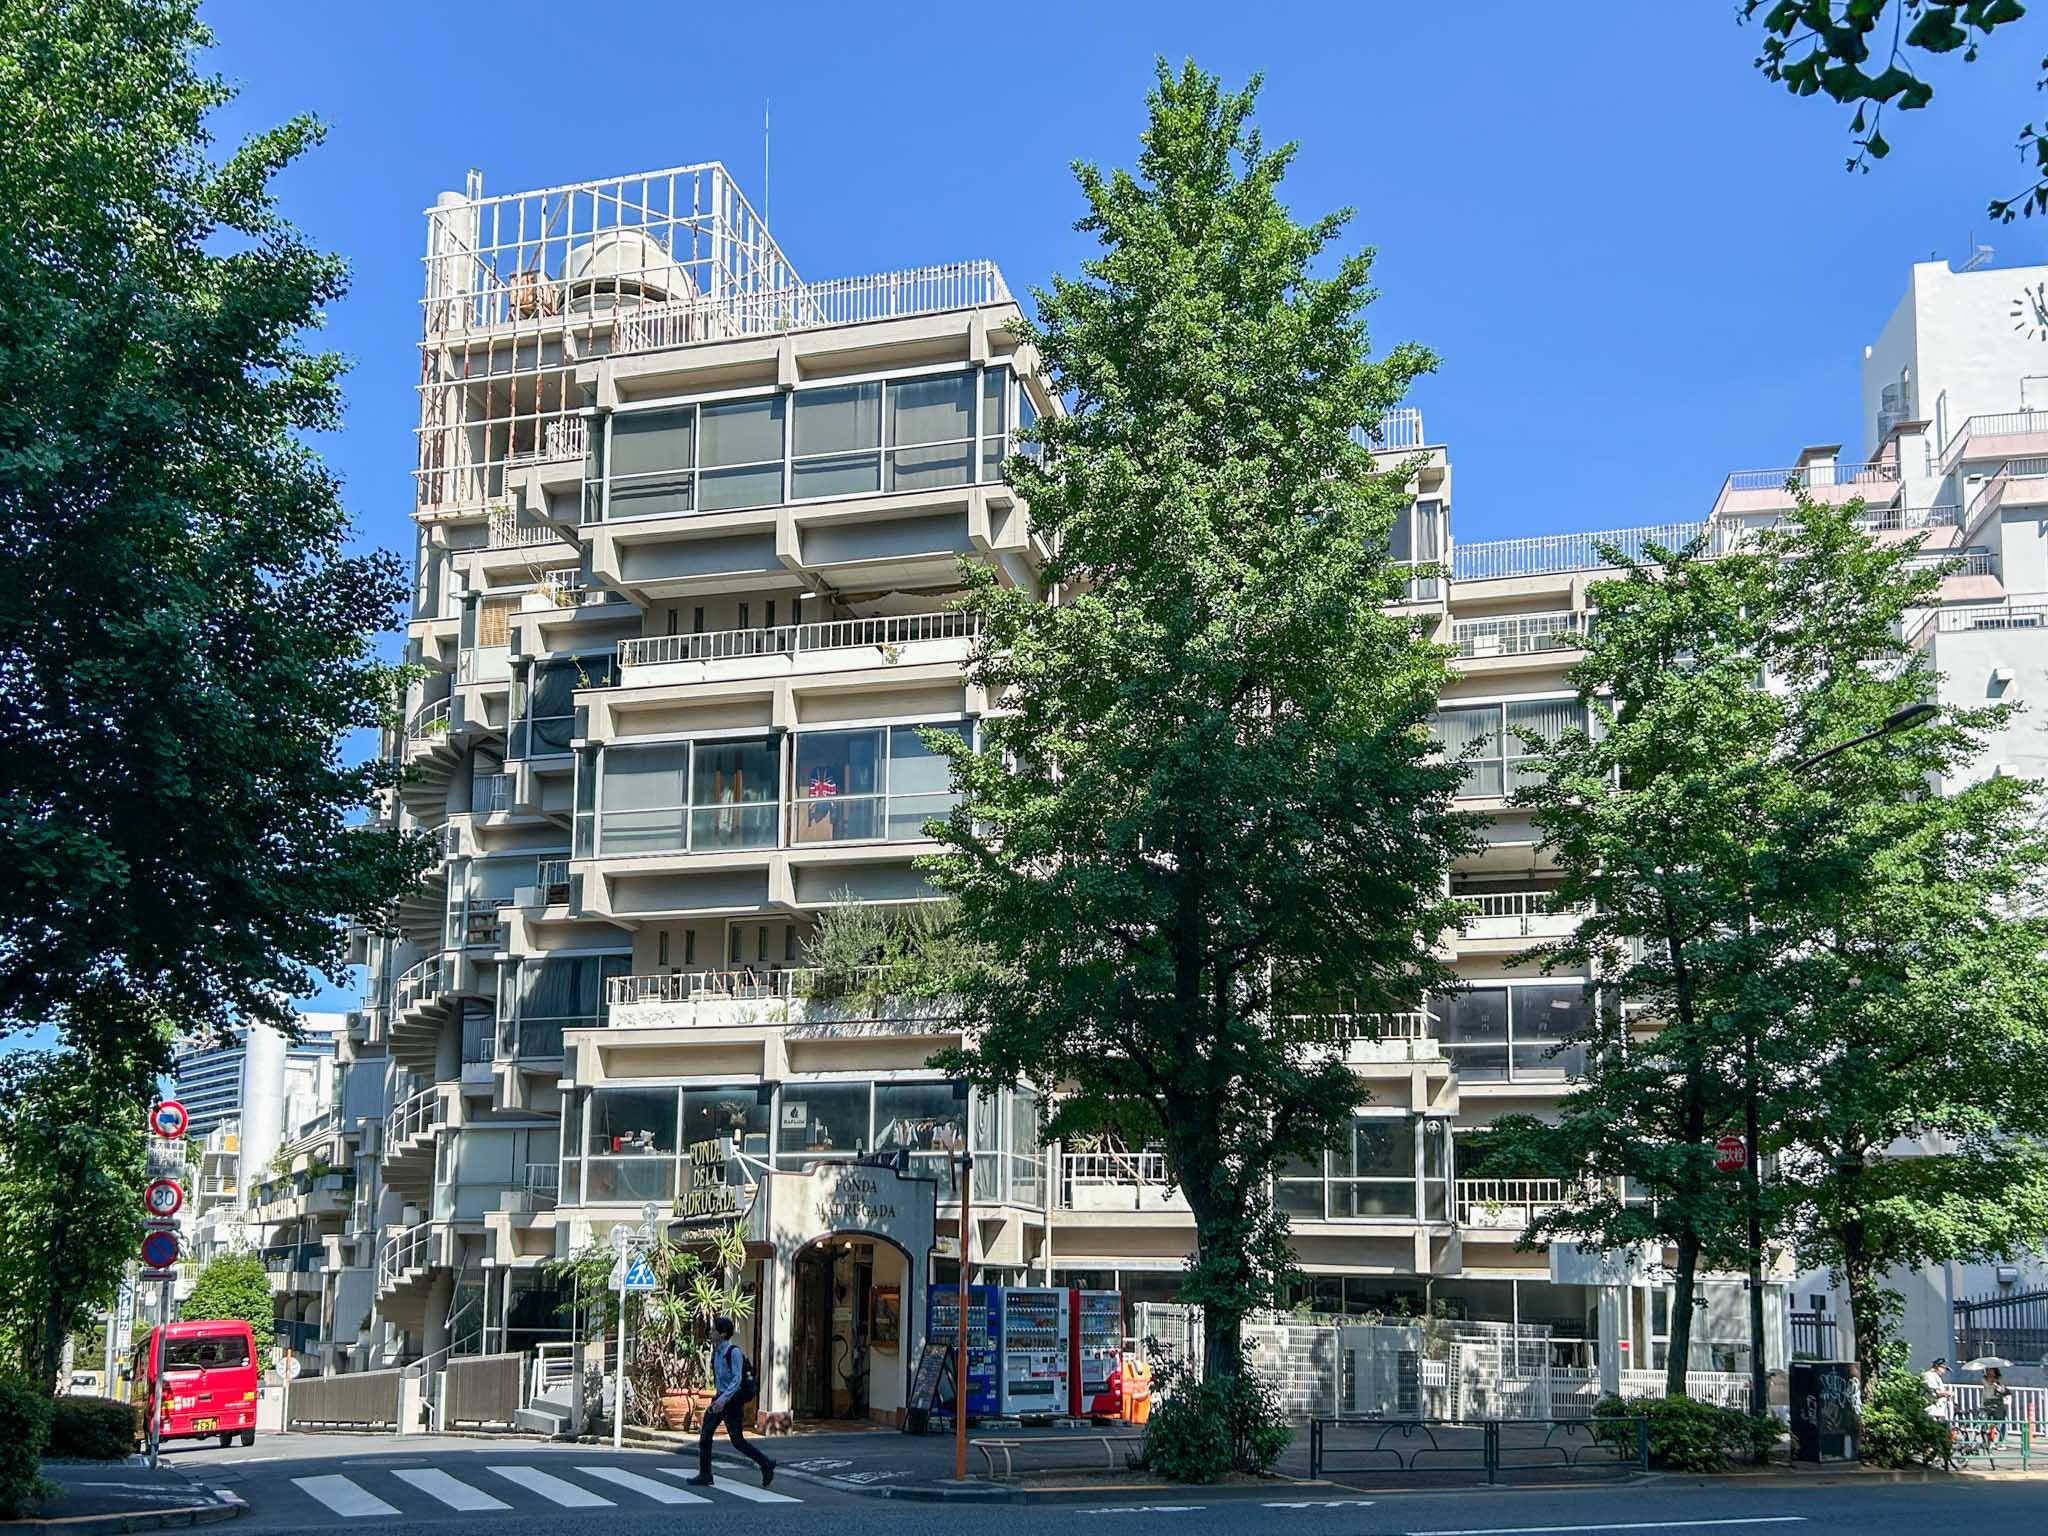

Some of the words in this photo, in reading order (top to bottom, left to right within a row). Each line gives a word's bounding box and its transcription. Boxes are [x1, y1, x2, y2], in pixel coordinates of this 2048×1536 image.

[689, 1139, 723, 1166] FONDA
[835, 1179, 877, 1193] FONDA
[153, 1190, 175, 1207] 30
[672, 1186, 737, 1217] MADRUGADA
[815, 1203, 896, 1218] MADRUGADA
